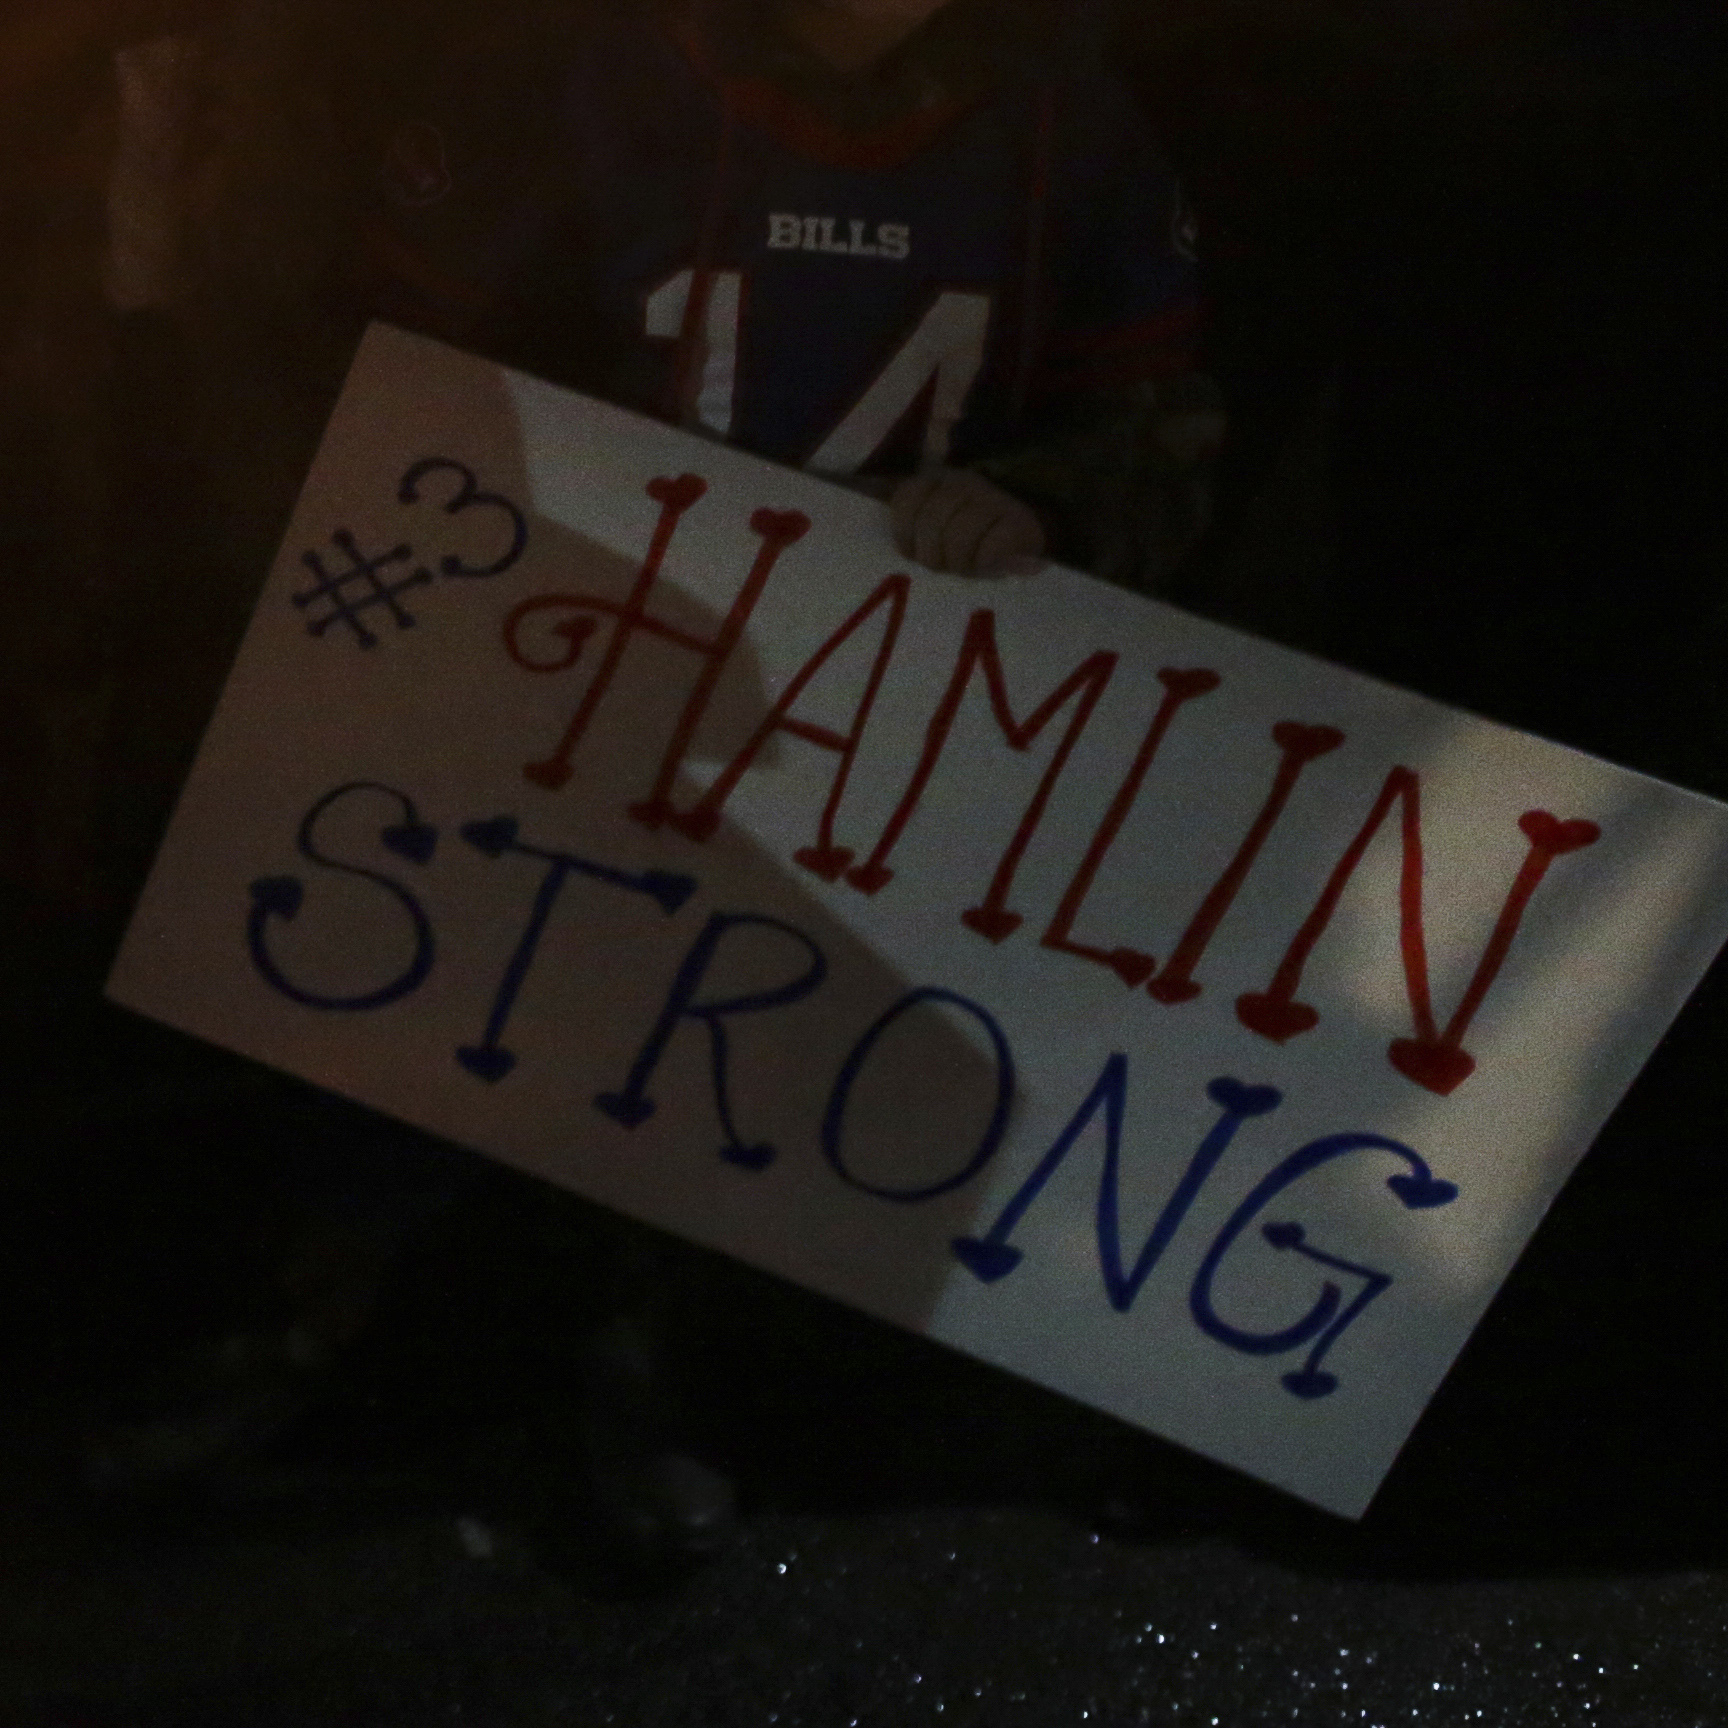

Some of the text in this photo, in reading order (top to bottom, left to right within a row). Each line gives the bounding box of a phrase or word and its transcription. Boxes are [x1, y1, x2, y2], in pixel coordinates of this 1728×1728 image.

[767, 212, 910, 260] BILLS
[644, 268, 992, 474] 14
[291, 455, 528, 651] #3
[500, 471, 1601, 1096] HAMLIN
[246, 781, 1461, 1401] STRONG
